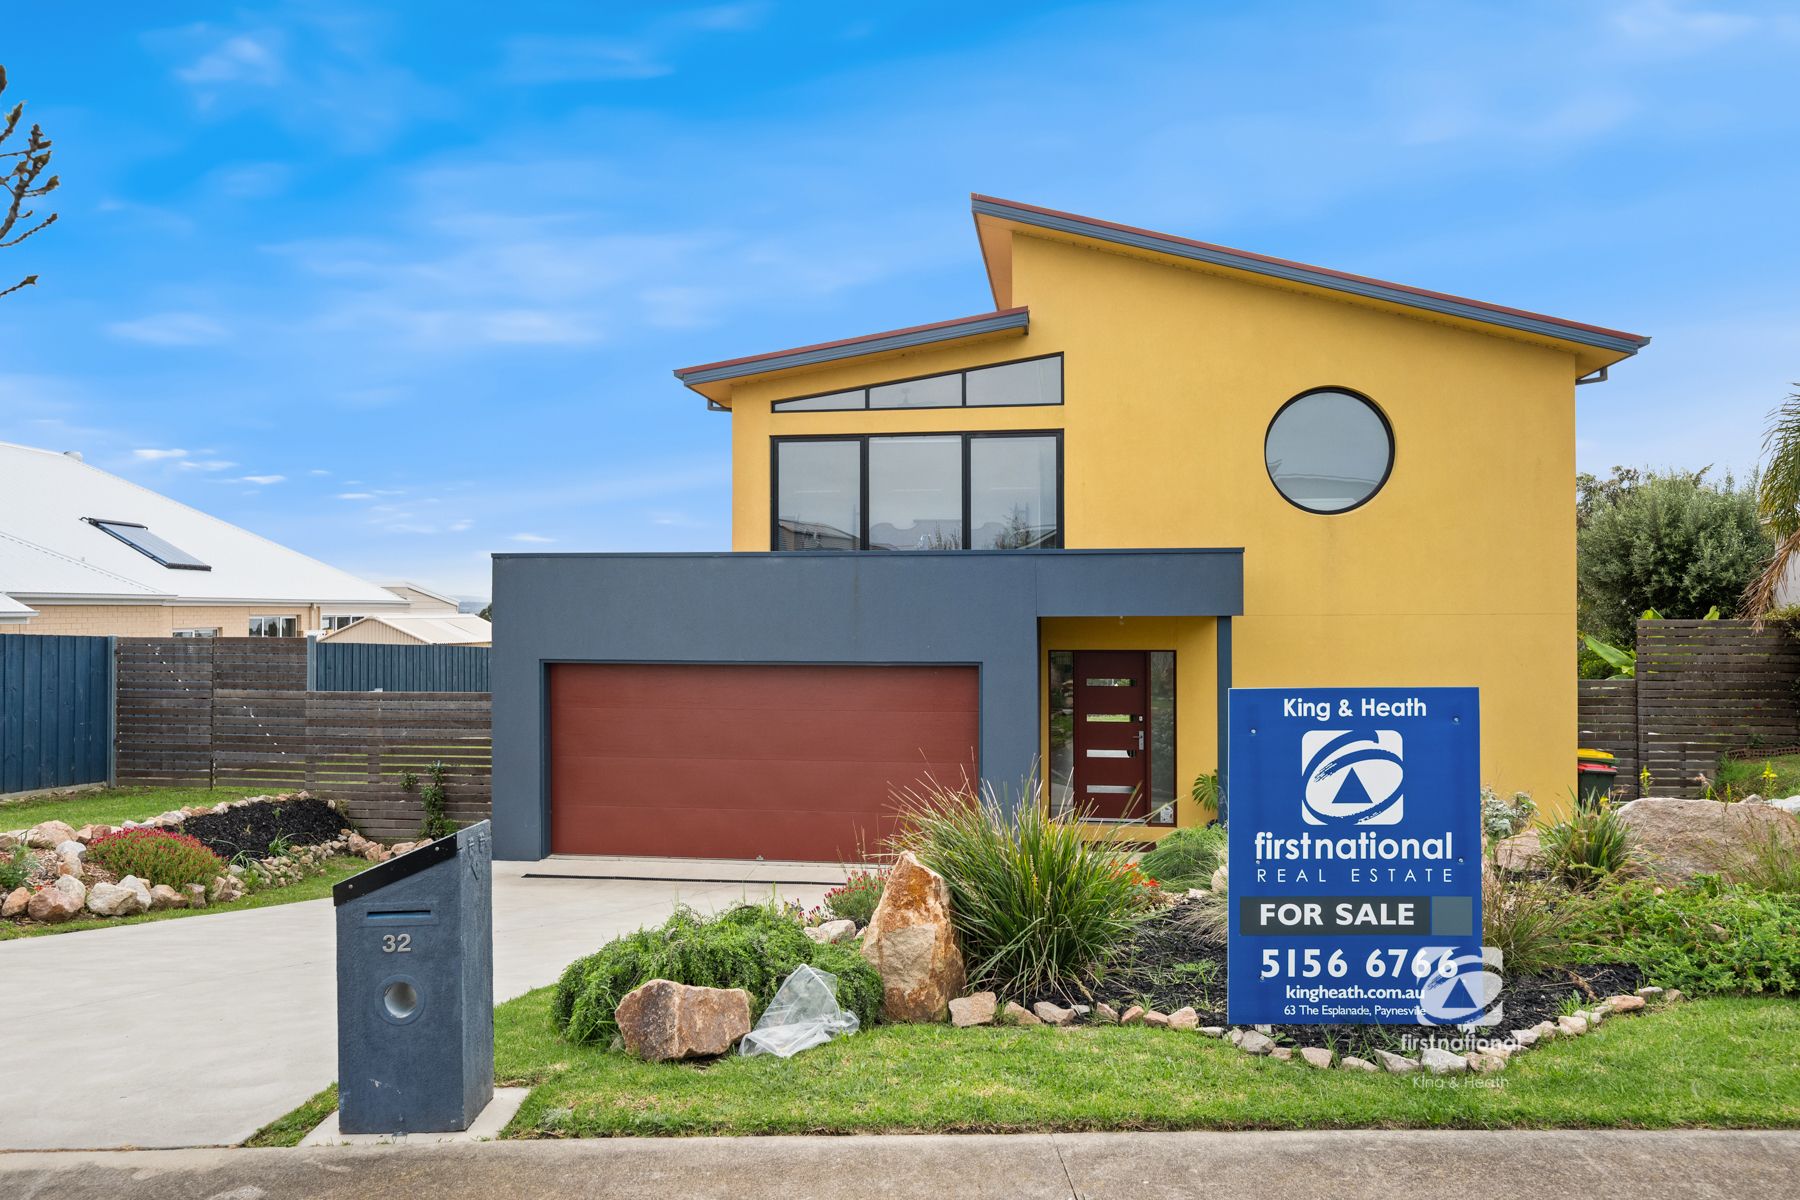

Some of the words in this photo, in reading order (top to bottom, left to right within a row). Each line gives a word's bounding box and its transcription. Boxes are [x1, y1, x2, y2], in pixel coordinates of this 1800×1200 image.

[1284, 697, 1331, 722] King
[1338, 699, 1354, 717] &
[1361, 697, 1427, 717] Heath
[1257, 868, 1327, 883] REAL
[1351, 868, 1452, 883] ESTATE
[1260, 903, 1323, 926] FOR
[1335, 903, 1415, 926] SALE
[382, 933, 412, 953] 32
[1261, 948, 1348, 978] 5156
[1365, 948, 1458, 978] 6766
[1286, 985, 1426, 1003] kingheath.com.au
[1284, 1005, 1296, 1016] 63
[1299, 1005, 1319, 1016] The
[1321, 1005, 1372, 1018] Esplanade,
